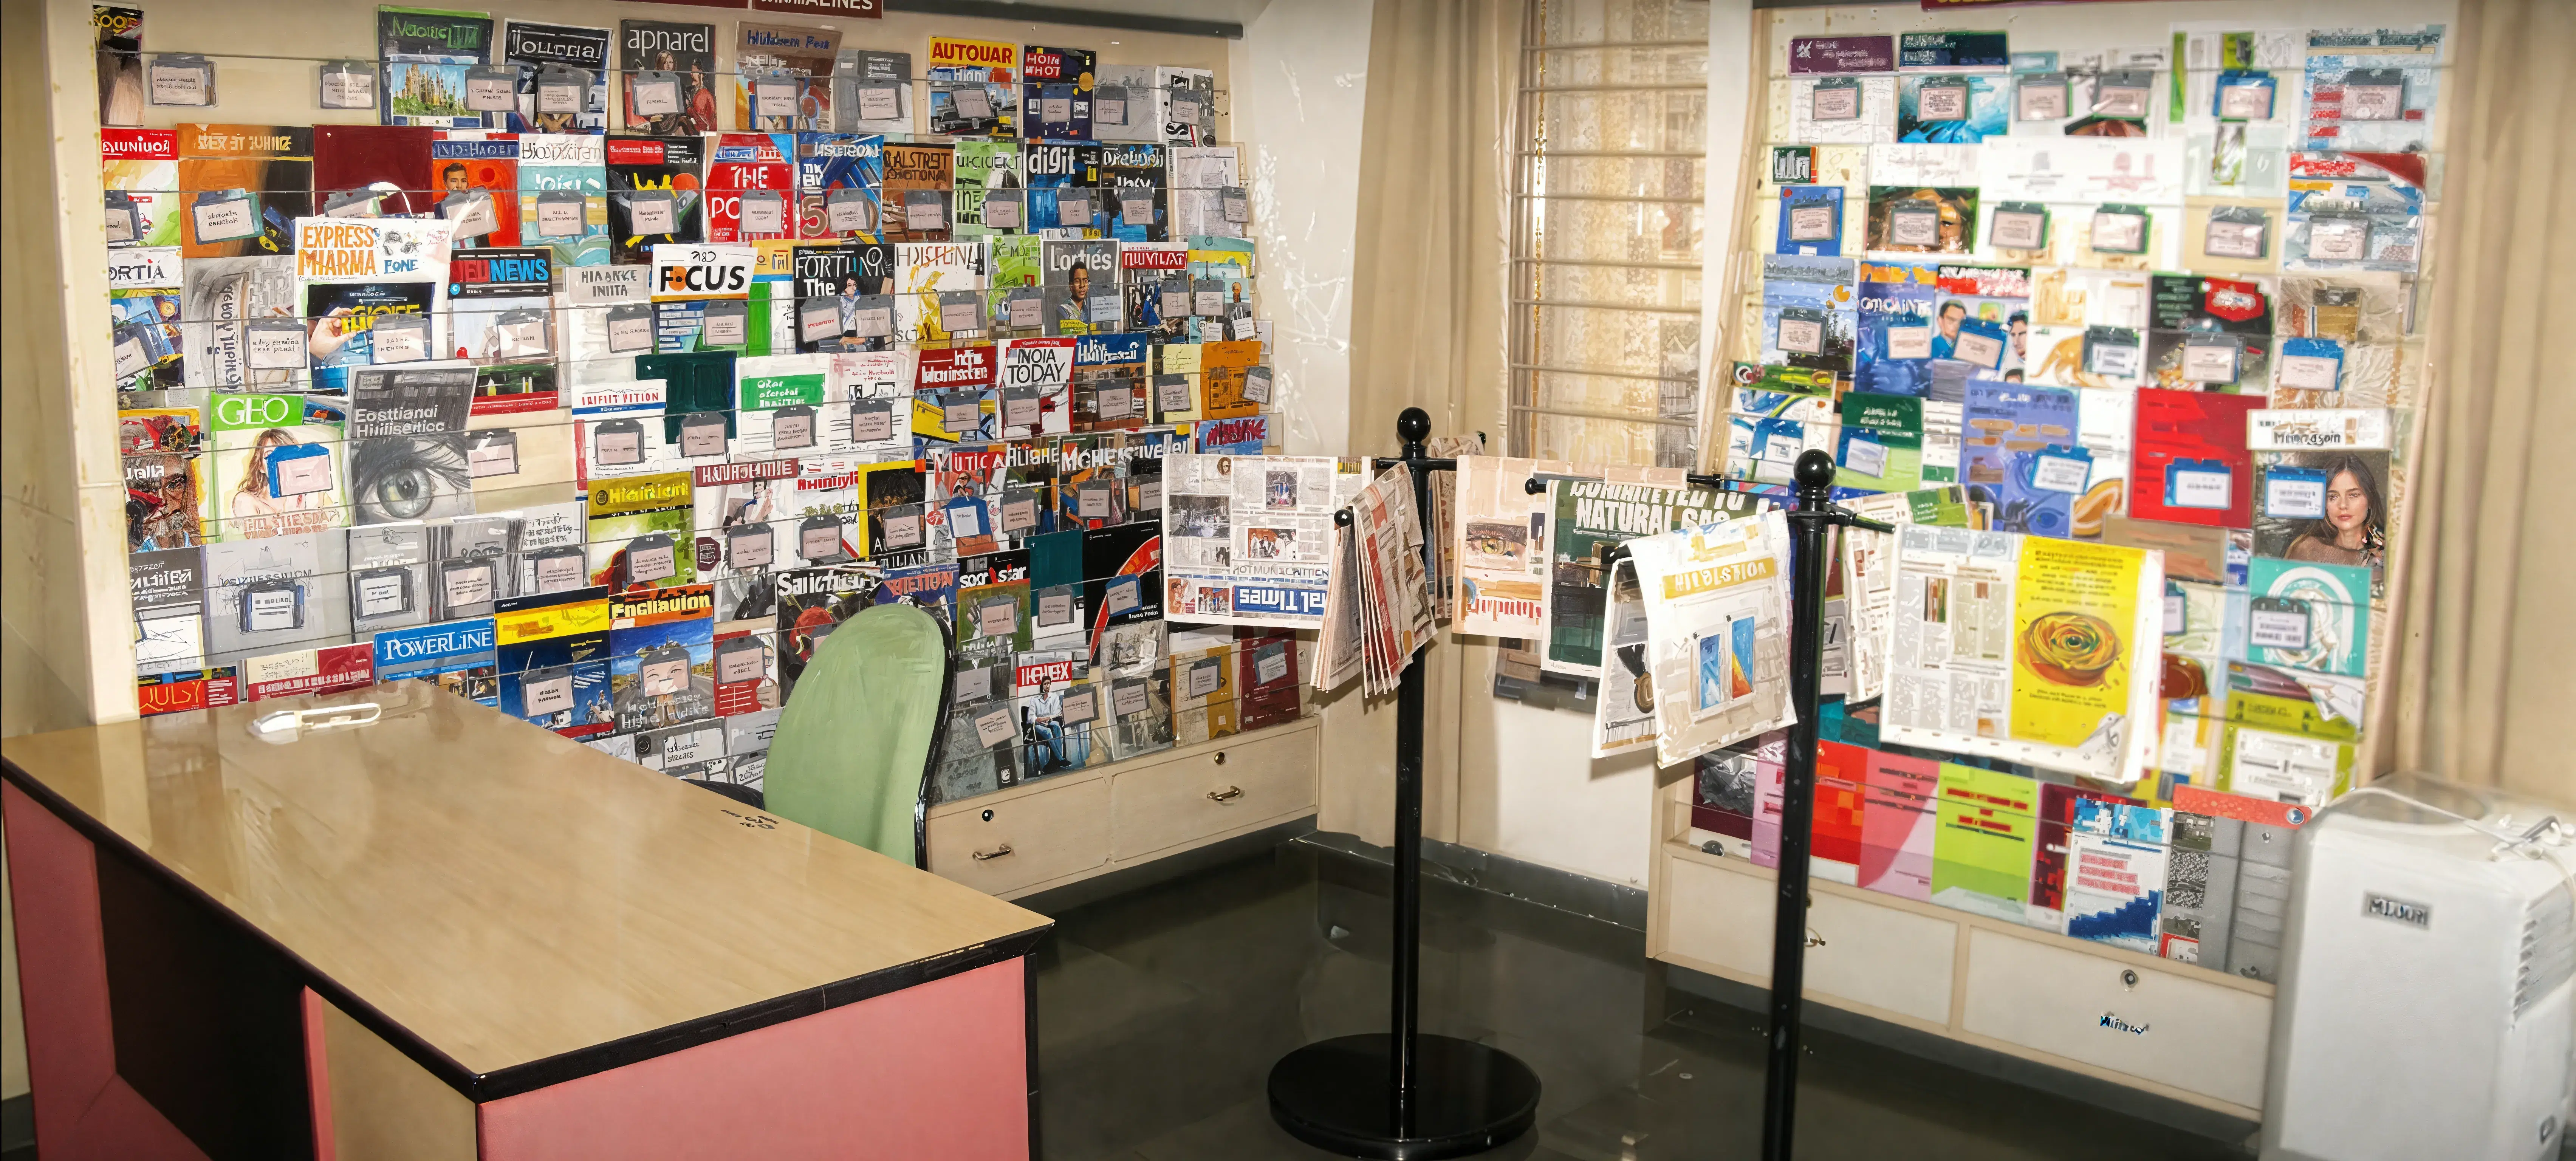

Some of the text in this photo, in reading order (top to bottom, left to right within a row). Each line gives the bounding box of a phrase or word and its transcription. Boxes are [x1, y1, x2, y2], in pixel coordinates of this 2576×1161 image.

[1029, 146, 1076, 174] digit
[303, 226, 374, 248] EXPRESS
[491, 259, 549, 282] NEWS
[803, 278, 835, 297] The
[1007, 362, 1066, 384] TODAY
[218, 397, 289, 425] GEO
